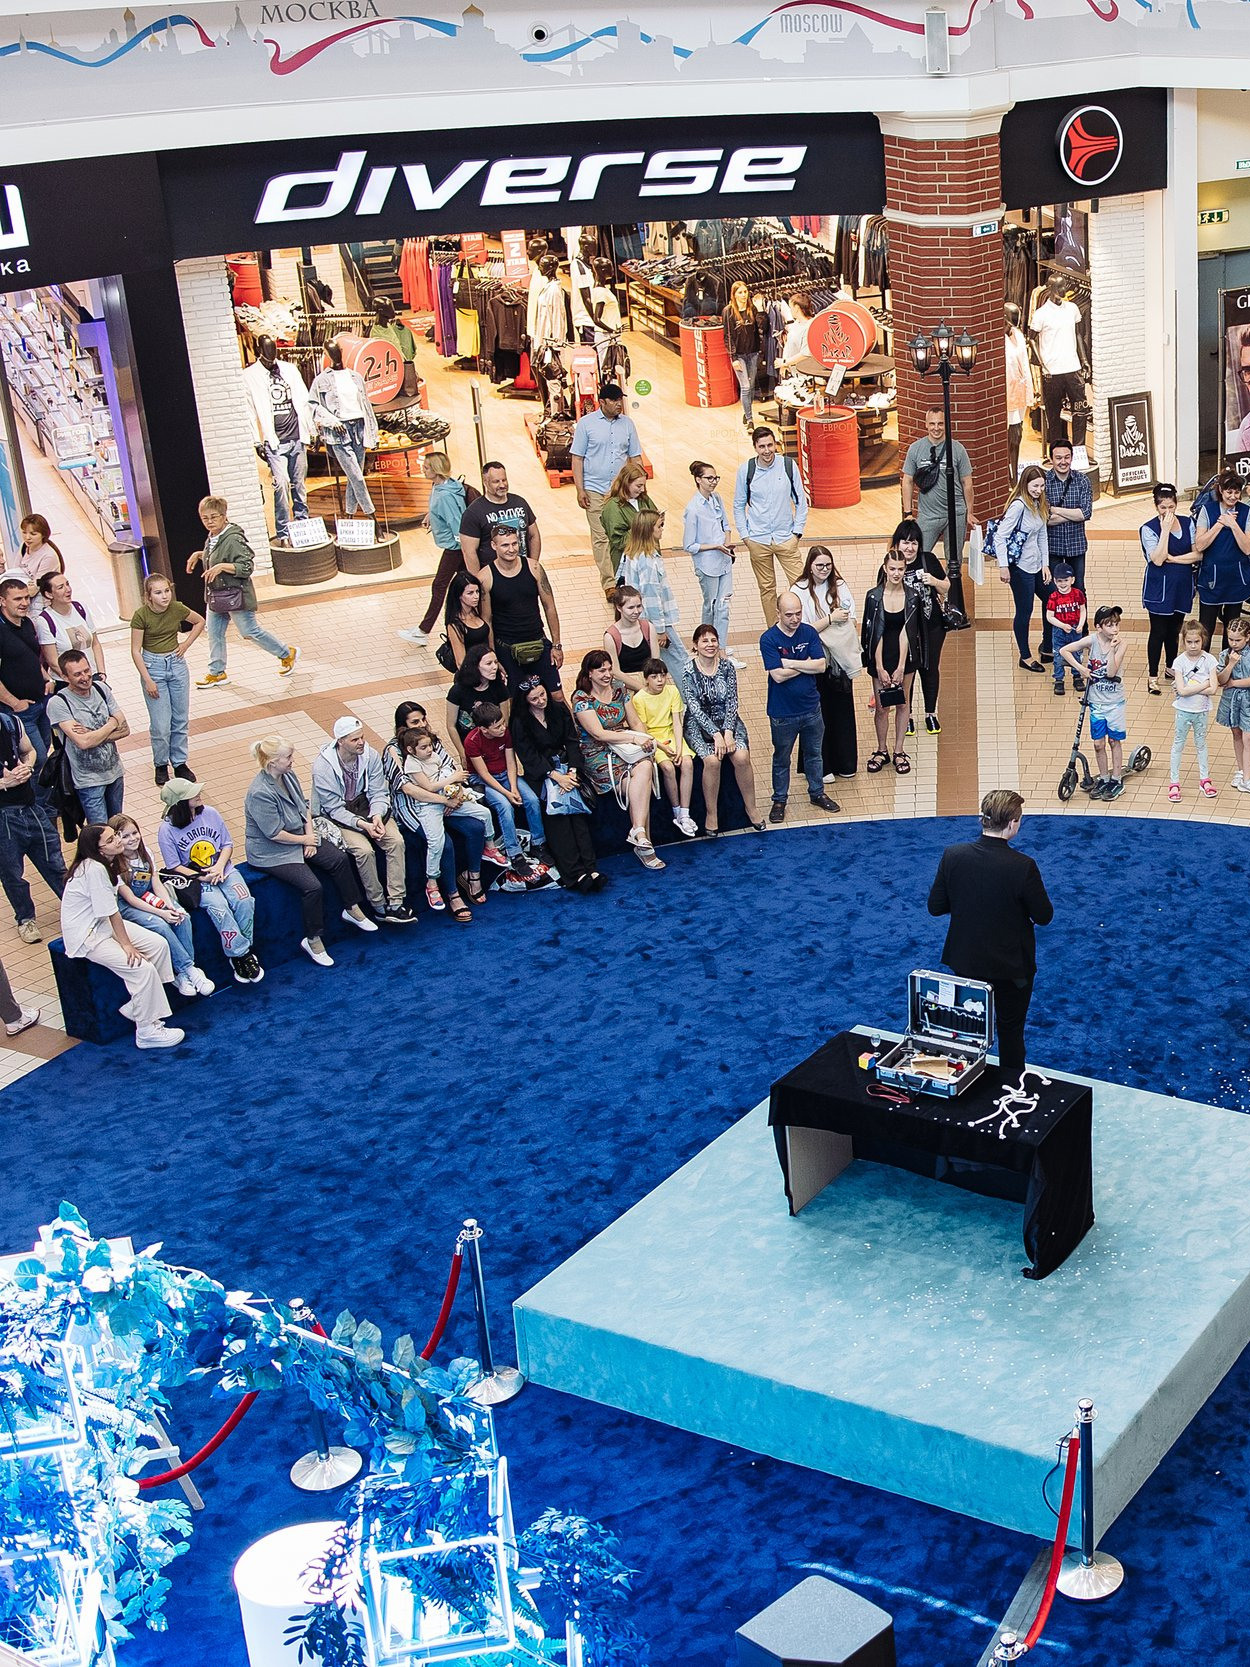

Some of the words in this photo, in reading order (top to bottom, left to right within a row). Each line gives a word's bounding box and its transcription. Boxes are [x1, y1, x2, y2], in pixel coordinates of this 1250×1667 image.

[260, 0, 380, 24] МОСКВА
[780, 13, 843, 33] MOSCOW
[254, 145, 808, 224] diverse
[694, 329, 709, 408] diverse
[1119, 442, 1148, 459] DAKAR
[1121, 469, 1147, 478] OFFICIAL
[1121, 474, 1148, 483] PRODUCT
[187, 826, 221, 842] ORIGINAL
